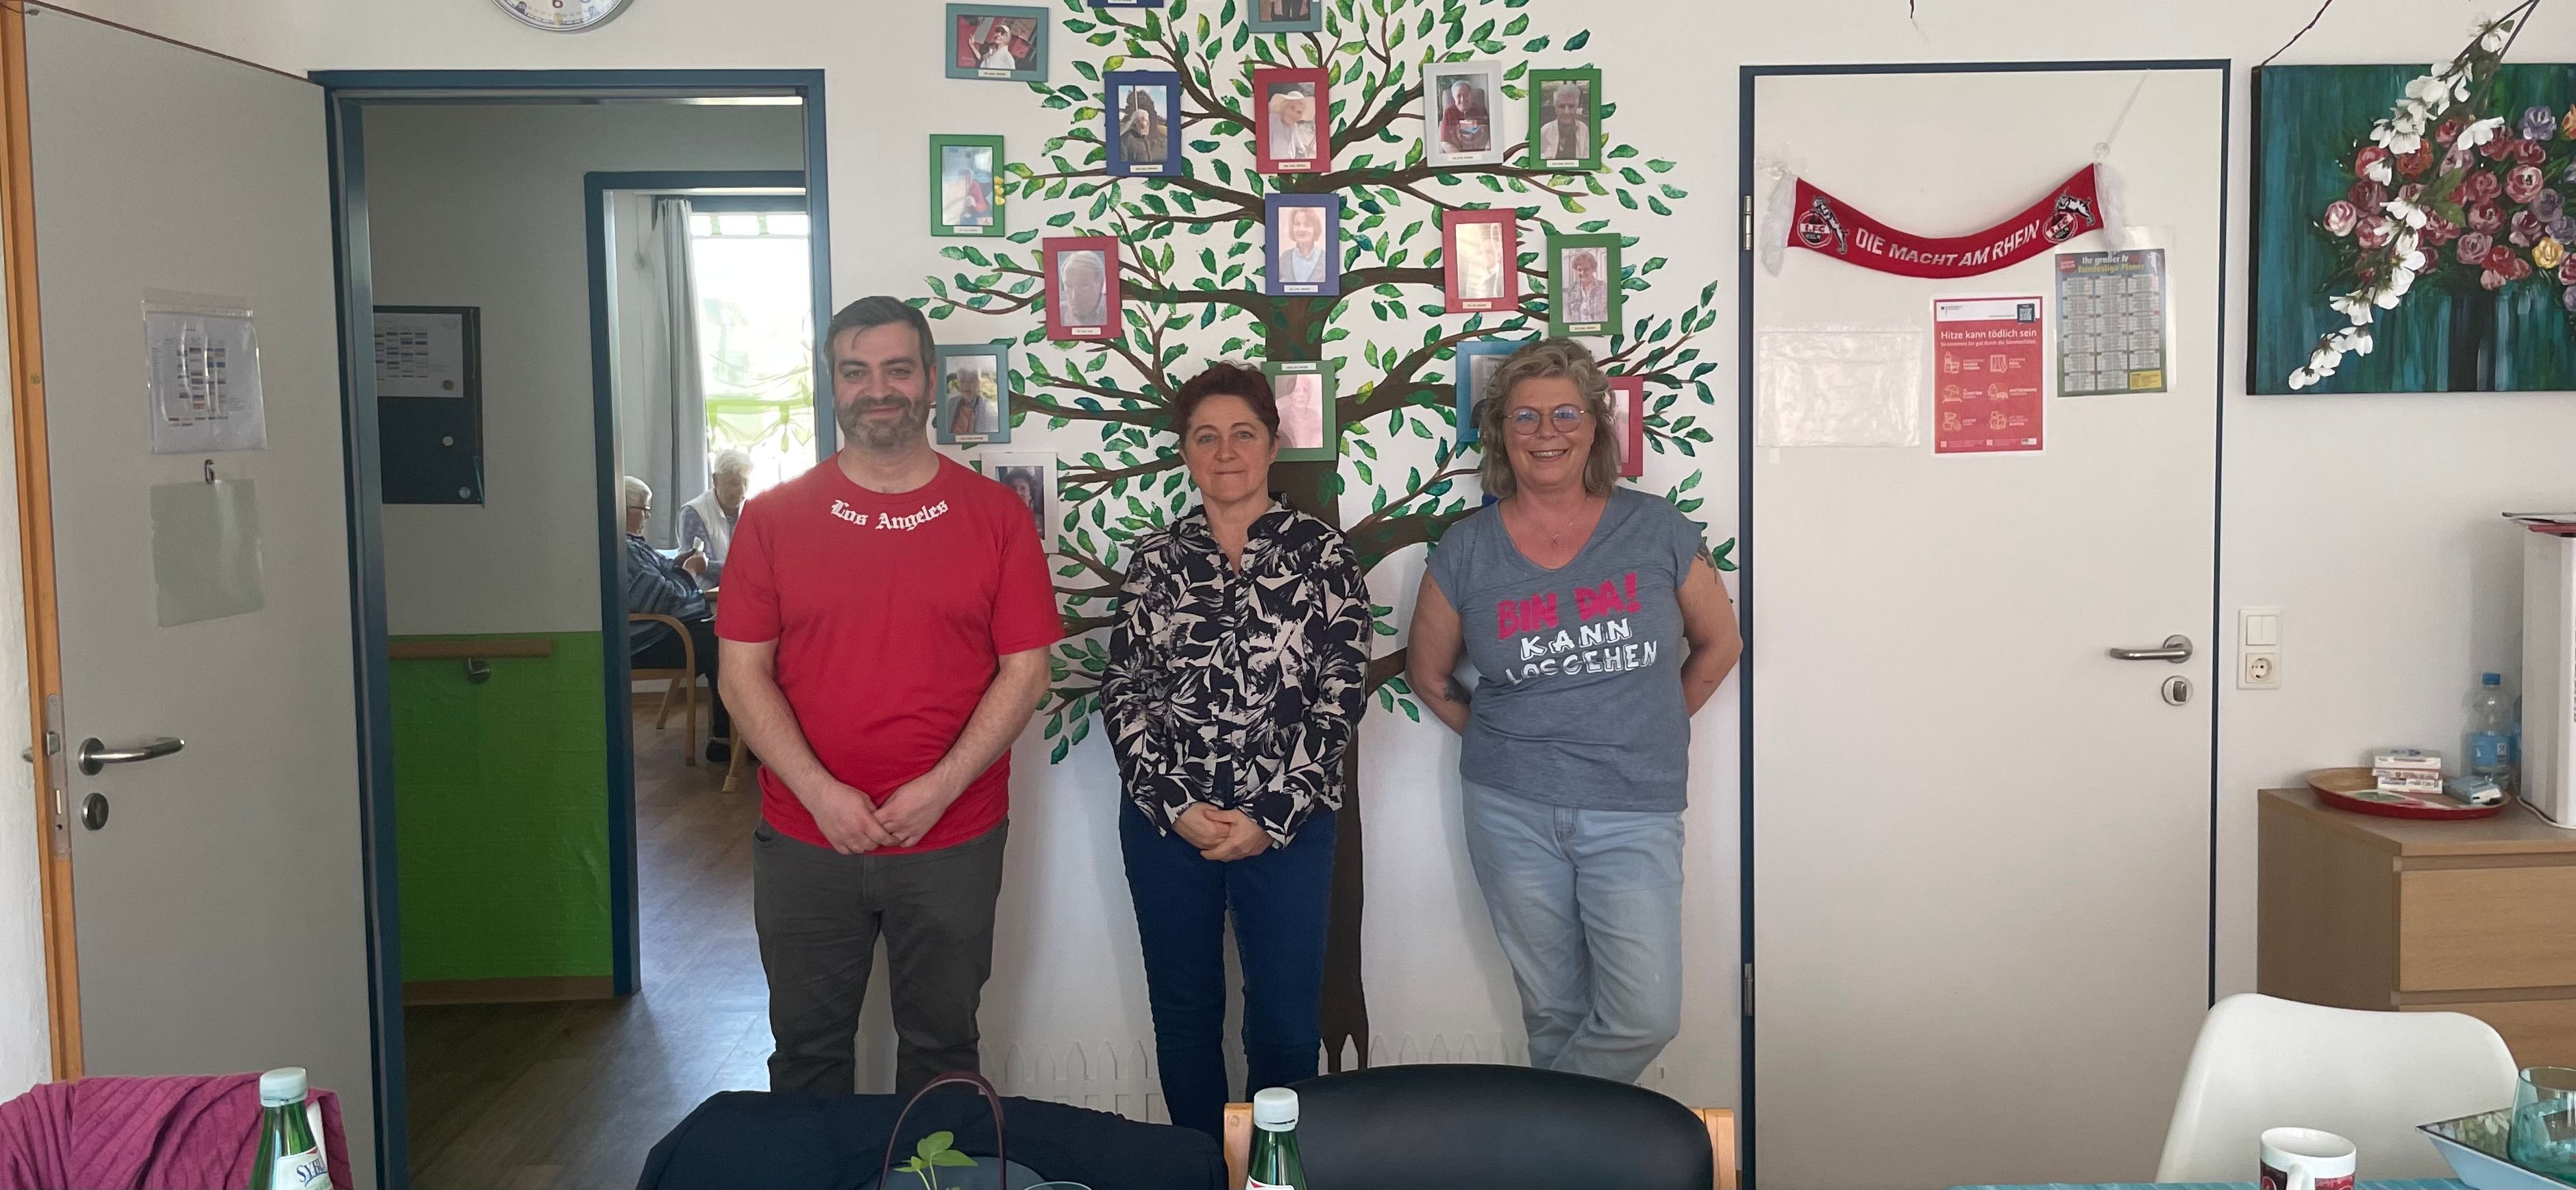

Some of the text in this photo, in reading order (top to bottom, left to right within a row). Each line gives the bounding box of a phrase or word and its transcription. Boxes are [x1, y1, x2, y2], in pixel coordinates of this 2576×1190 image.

[1855, 219, 2040, 266] DIE MACHT AM RHEIN
[1941, 328, 2037, 340] Hitze kann tödlich sein
[831, 499, 949, 532] Los Angeles
[1498, 572, 1643, 641] BIN DA!
[1520, 618, 1633, 661] KANN
[1506, 641, 1657, 685] LOSGEHEN
[297, 1156, 325, 1183] SYBI
